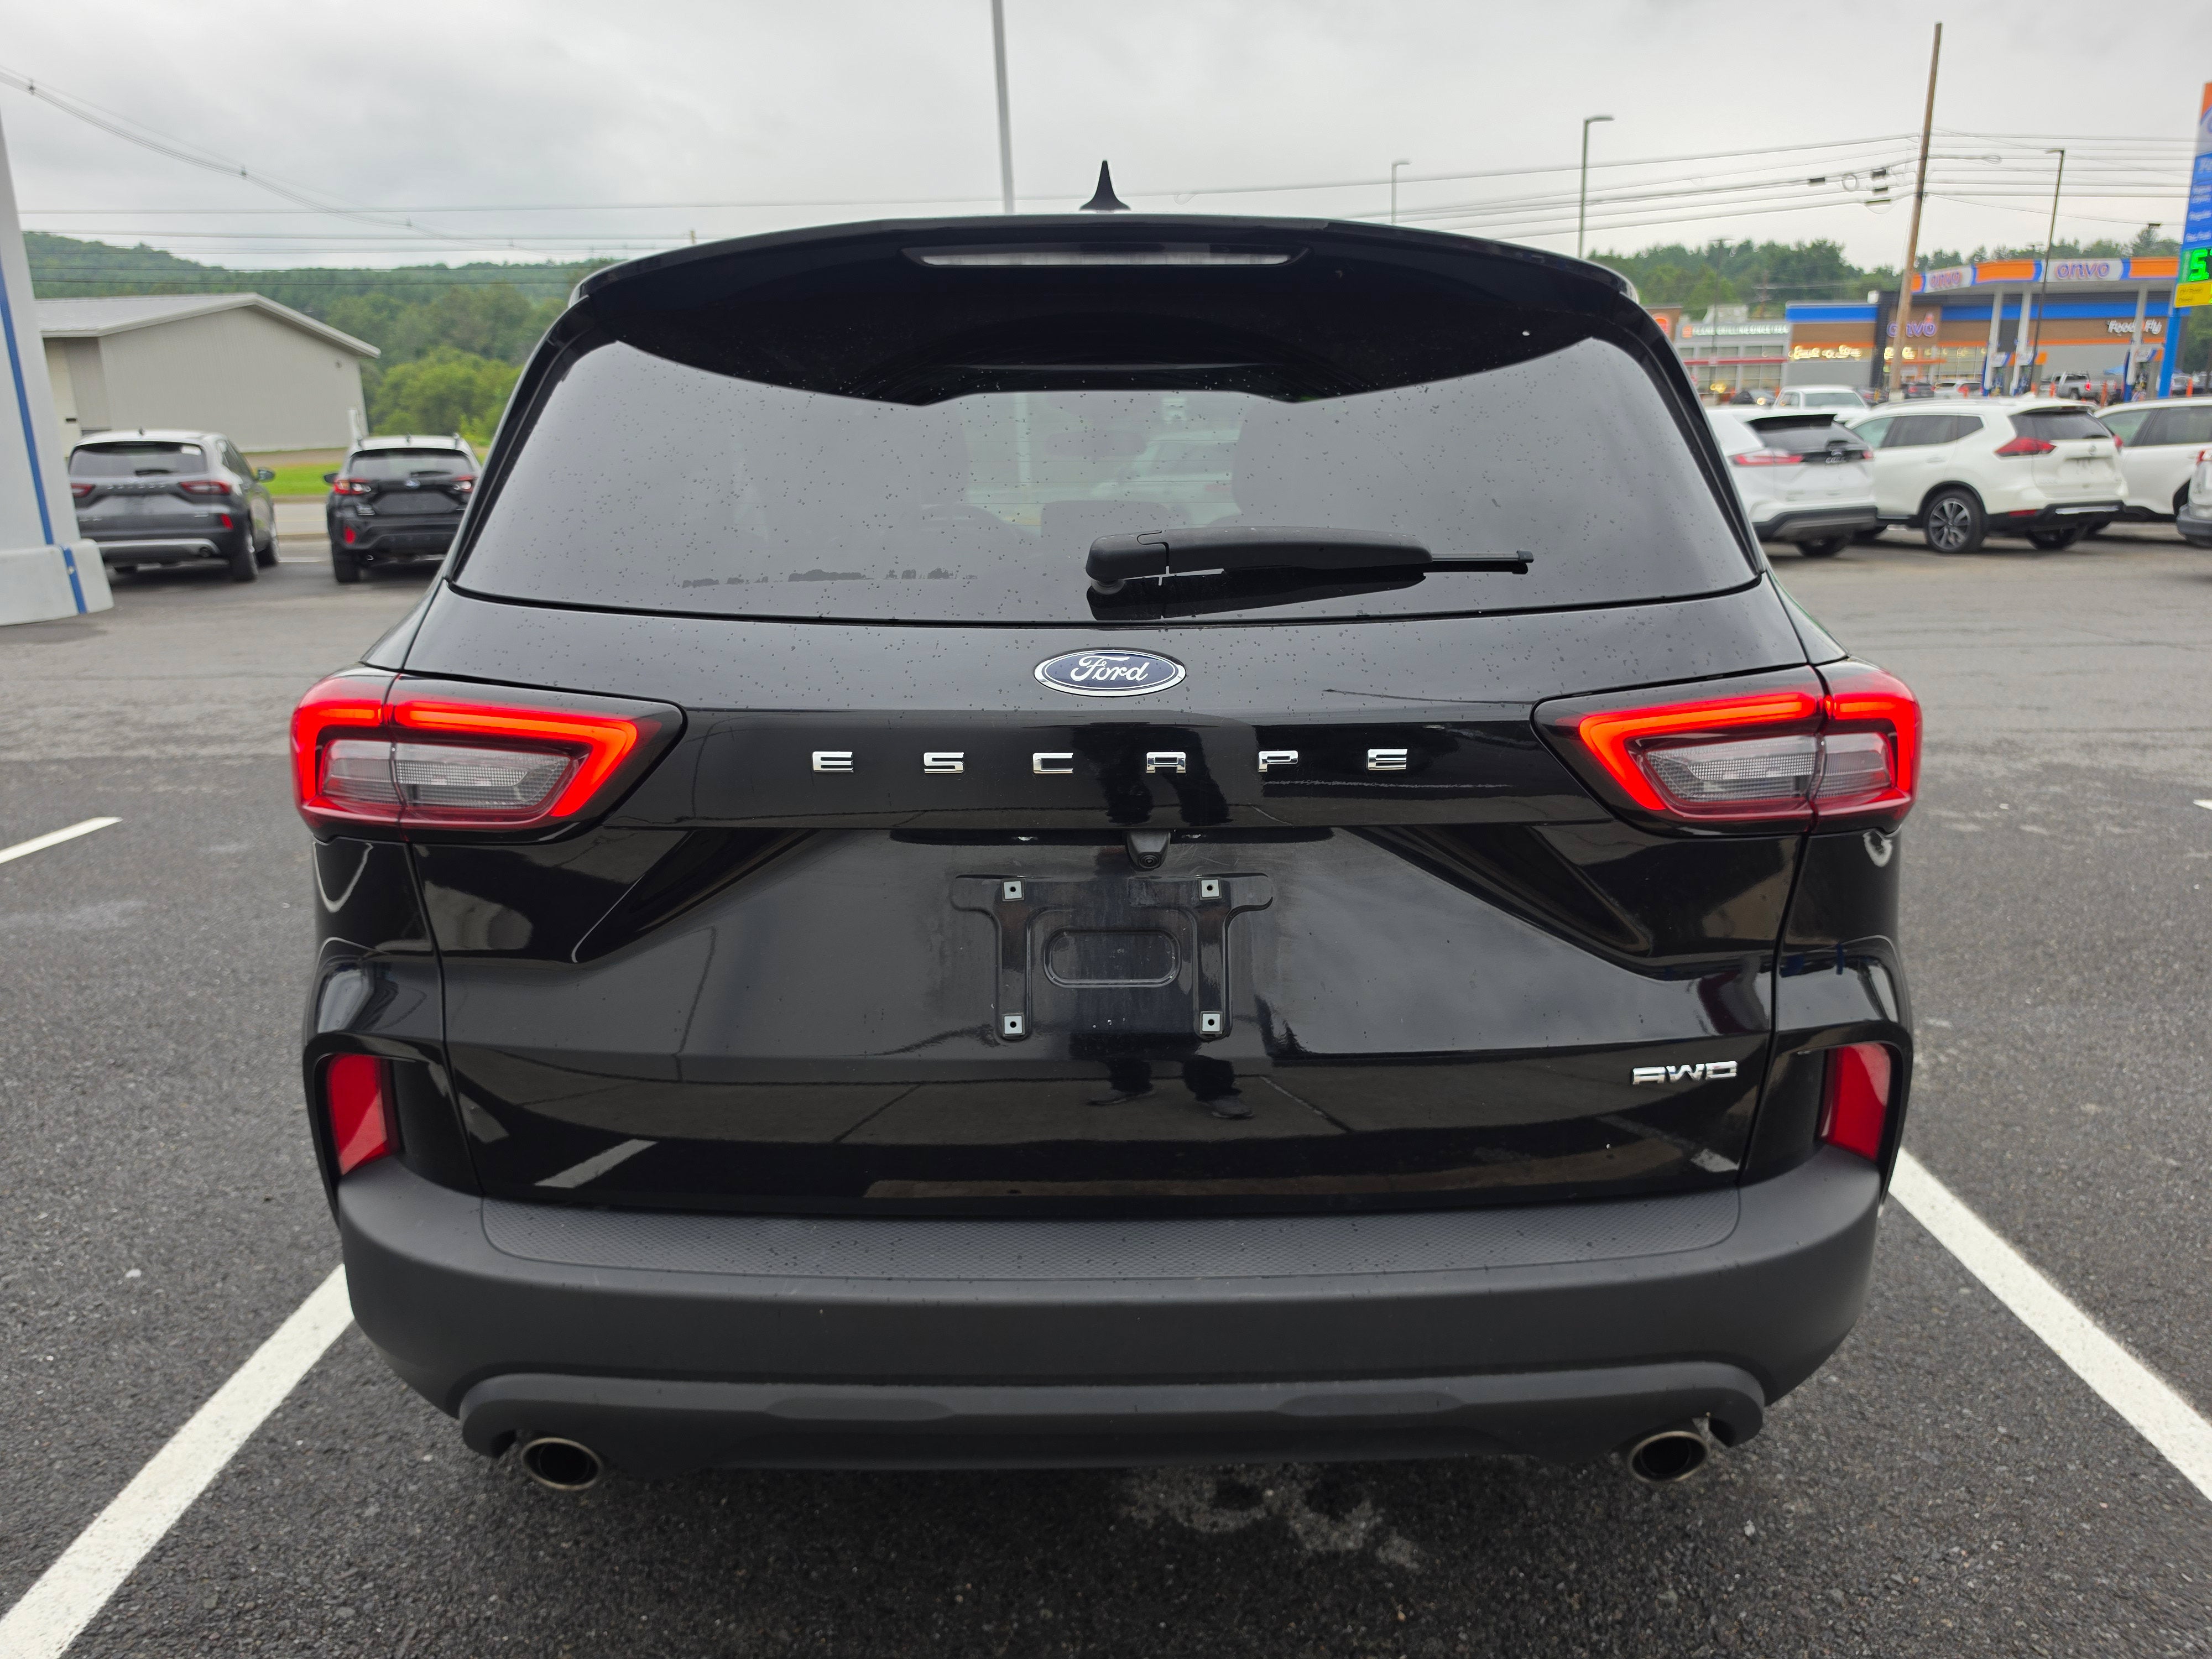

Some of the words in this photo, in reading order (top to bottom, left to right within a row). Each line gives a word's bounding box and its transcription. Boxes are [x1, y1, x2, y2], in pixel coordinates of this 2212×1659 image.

[2056, 262, 2110, 278] onvo
[1070, 655, 1150, 681] Ford
[812, 748, 1408, 774] ESCAPE
[1632, 1061, 1738, 1085] AWD
